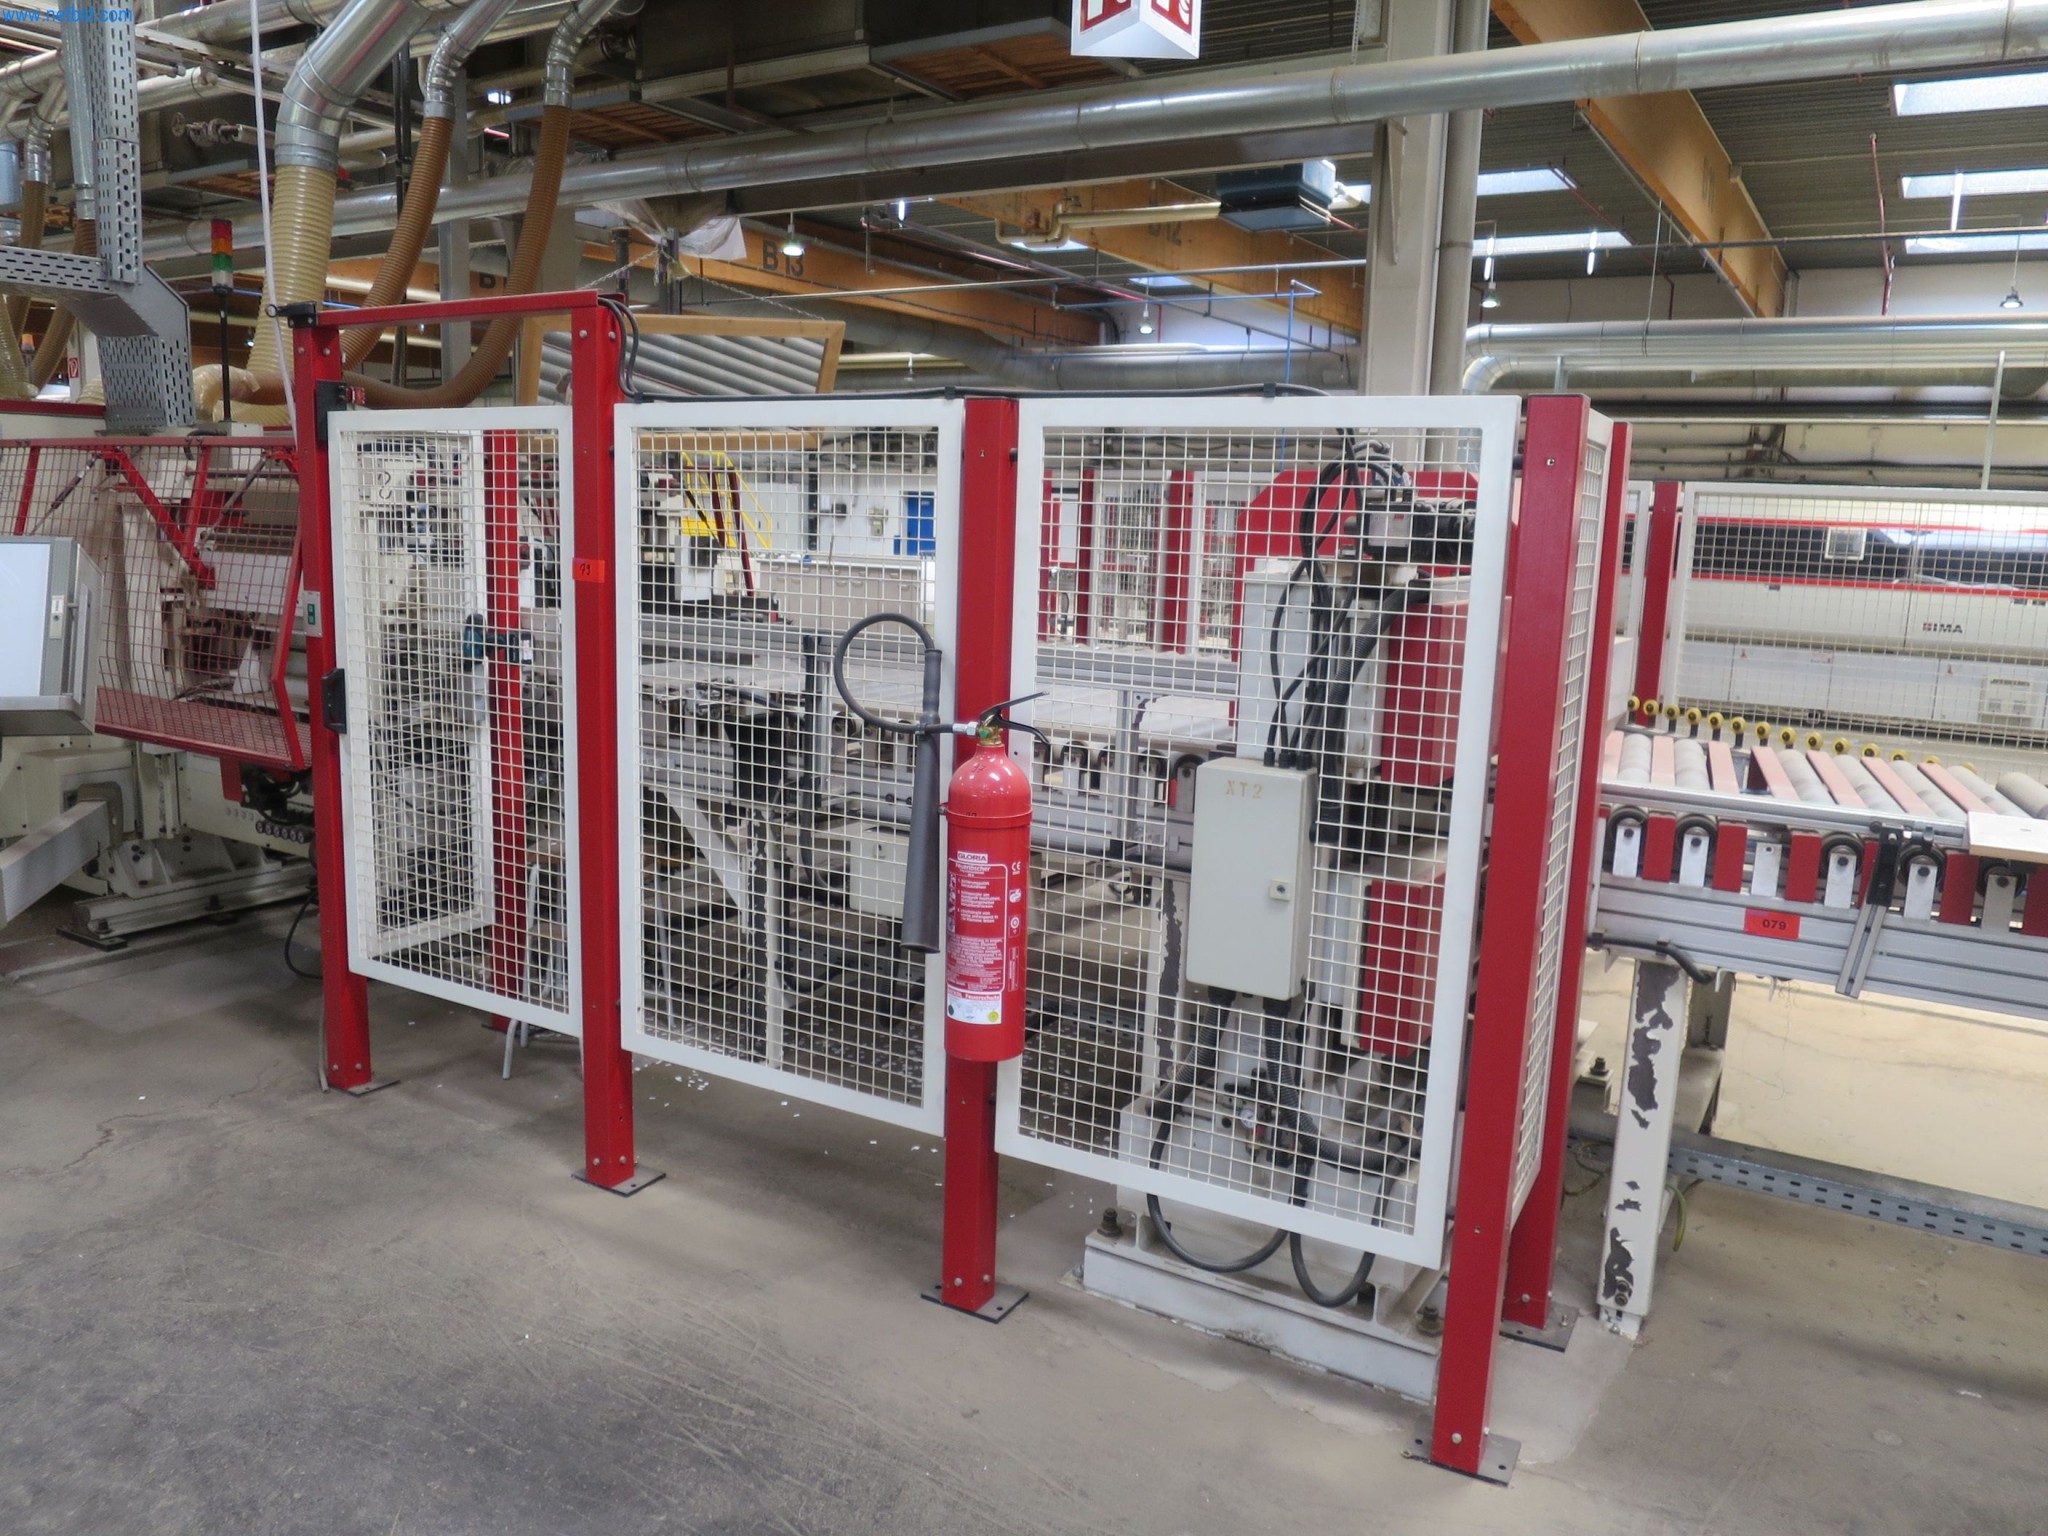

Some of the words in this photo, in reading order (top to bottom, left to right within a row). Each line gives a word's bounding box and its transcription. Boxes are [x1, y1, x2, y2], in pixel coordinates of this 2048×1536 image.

[763, 240, 779, 270] B
[958, 852, 987, 862] GLORIA
[1762, 918, 1787, 931] 079
